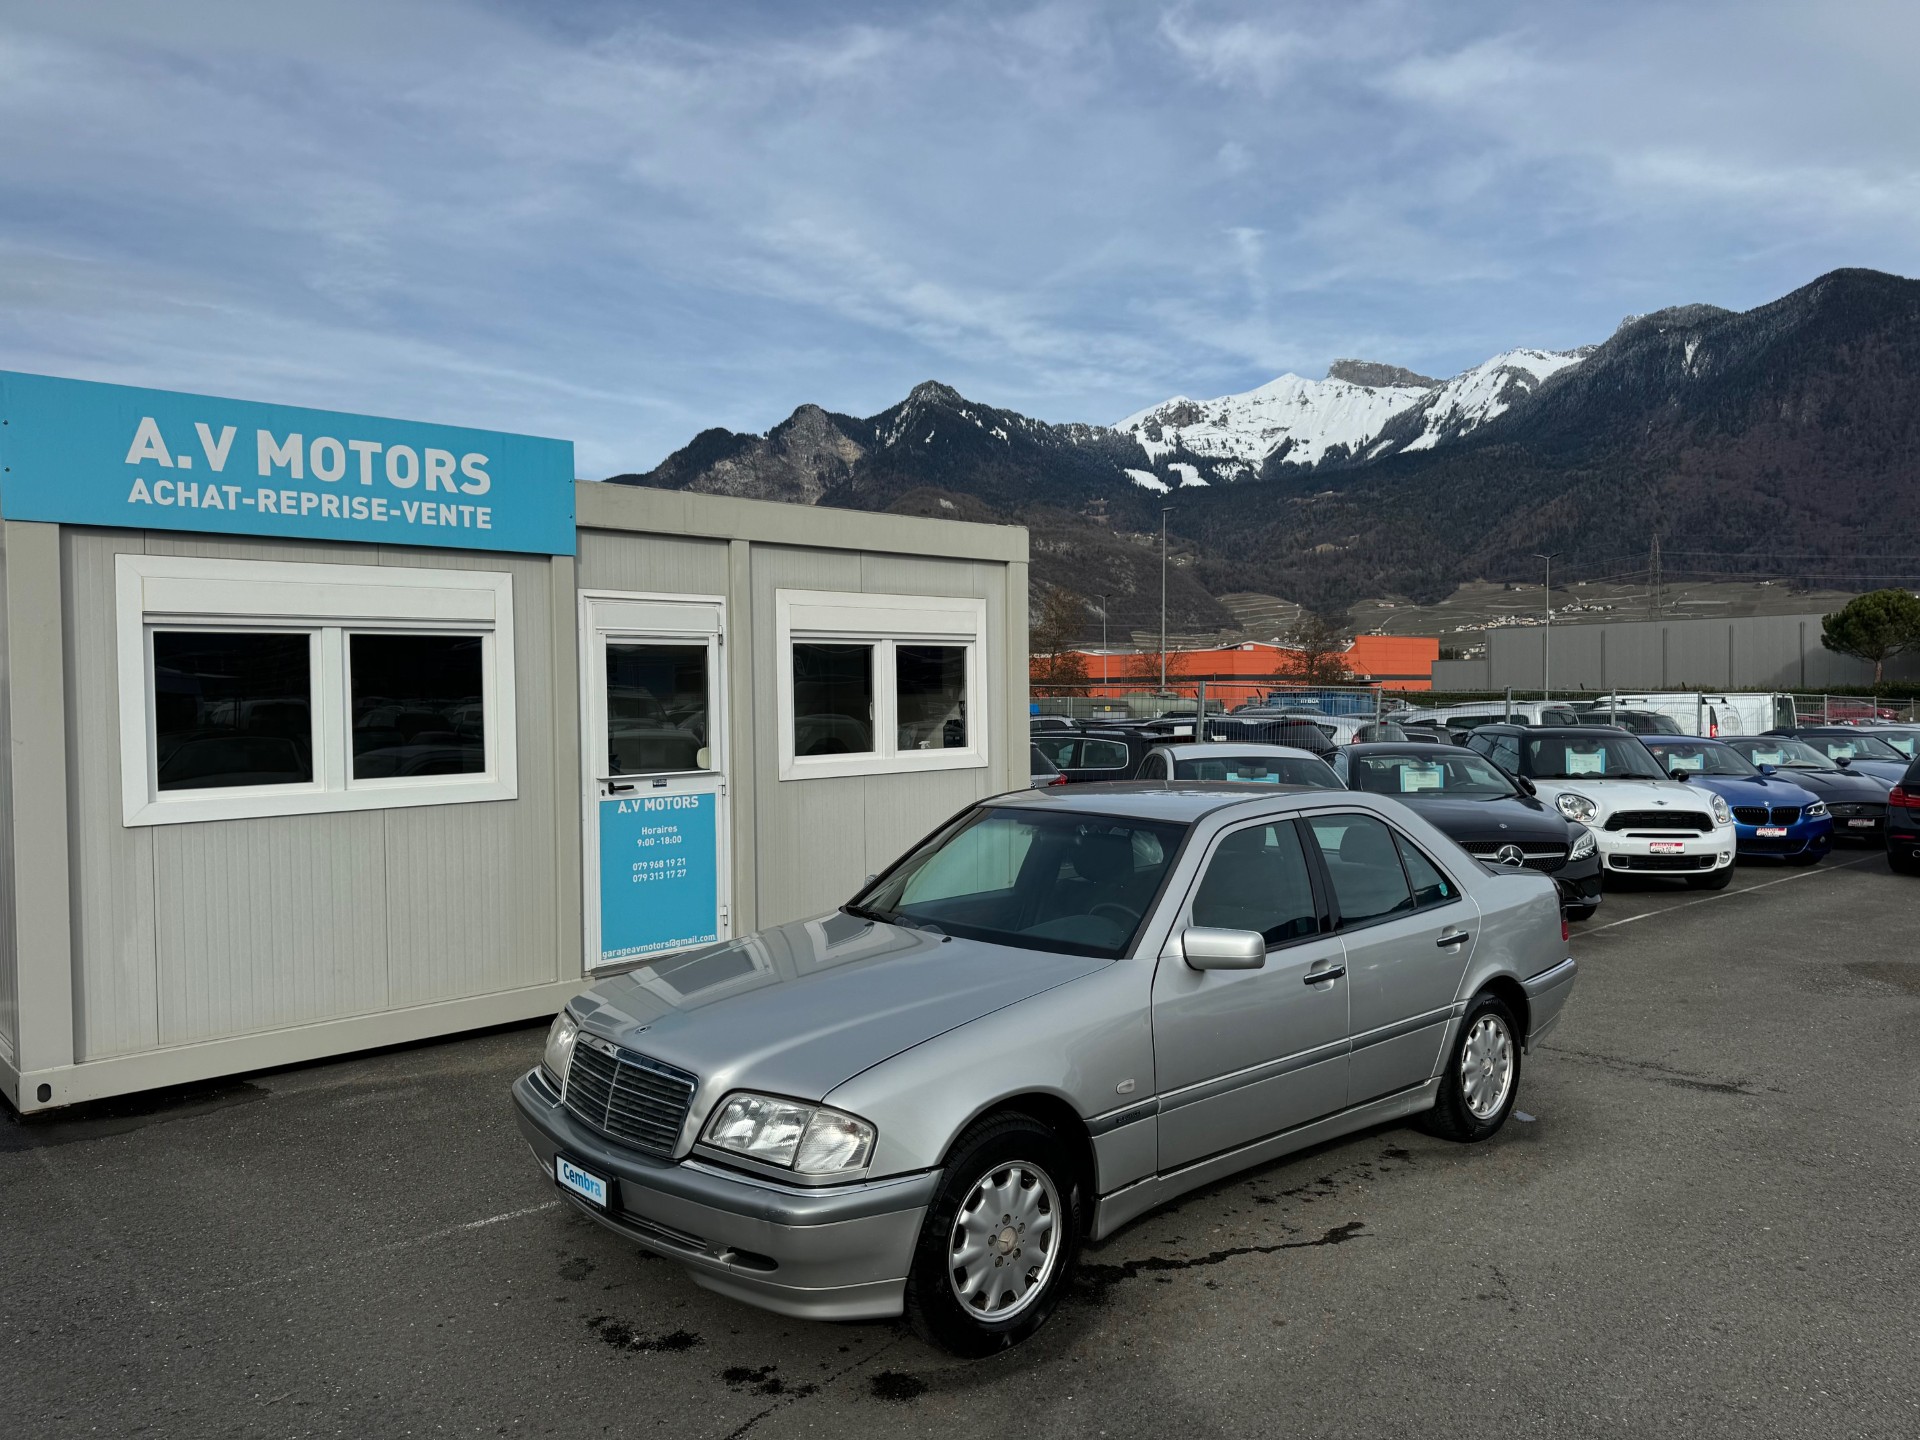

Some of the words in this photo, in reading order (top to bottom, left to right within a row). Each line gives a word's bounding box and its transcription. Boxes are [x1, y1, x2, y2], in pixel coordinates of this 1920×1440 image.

[125, 417, 237, 472] A.V
[257, 429, 491, 495] MOTORS
[127, 478, 492, 529] ACHAT-REPRISE-VENTE
[617, 800, 641, 814] A.V
[644, 796, 699, 811] MOTORS
[641, 825, 678, 836] Horaires
[637, 838, 655, 847] 9:00
[632, 862, 648, 871] 079
[649, 860, 664, 869] 968
[666, 858, 675, 868] 19
[676, 857, 686, 866] 21
[632, 873, 648, 883] 079
[649, 871, 664, 881] 313
[666, 870, 675, 879] 17
[676, 869, 687, 878] 27
[602, 934, 716, 960] garageavmotors@gmail.com
[563, 1162, 602, 1198] Cembra
